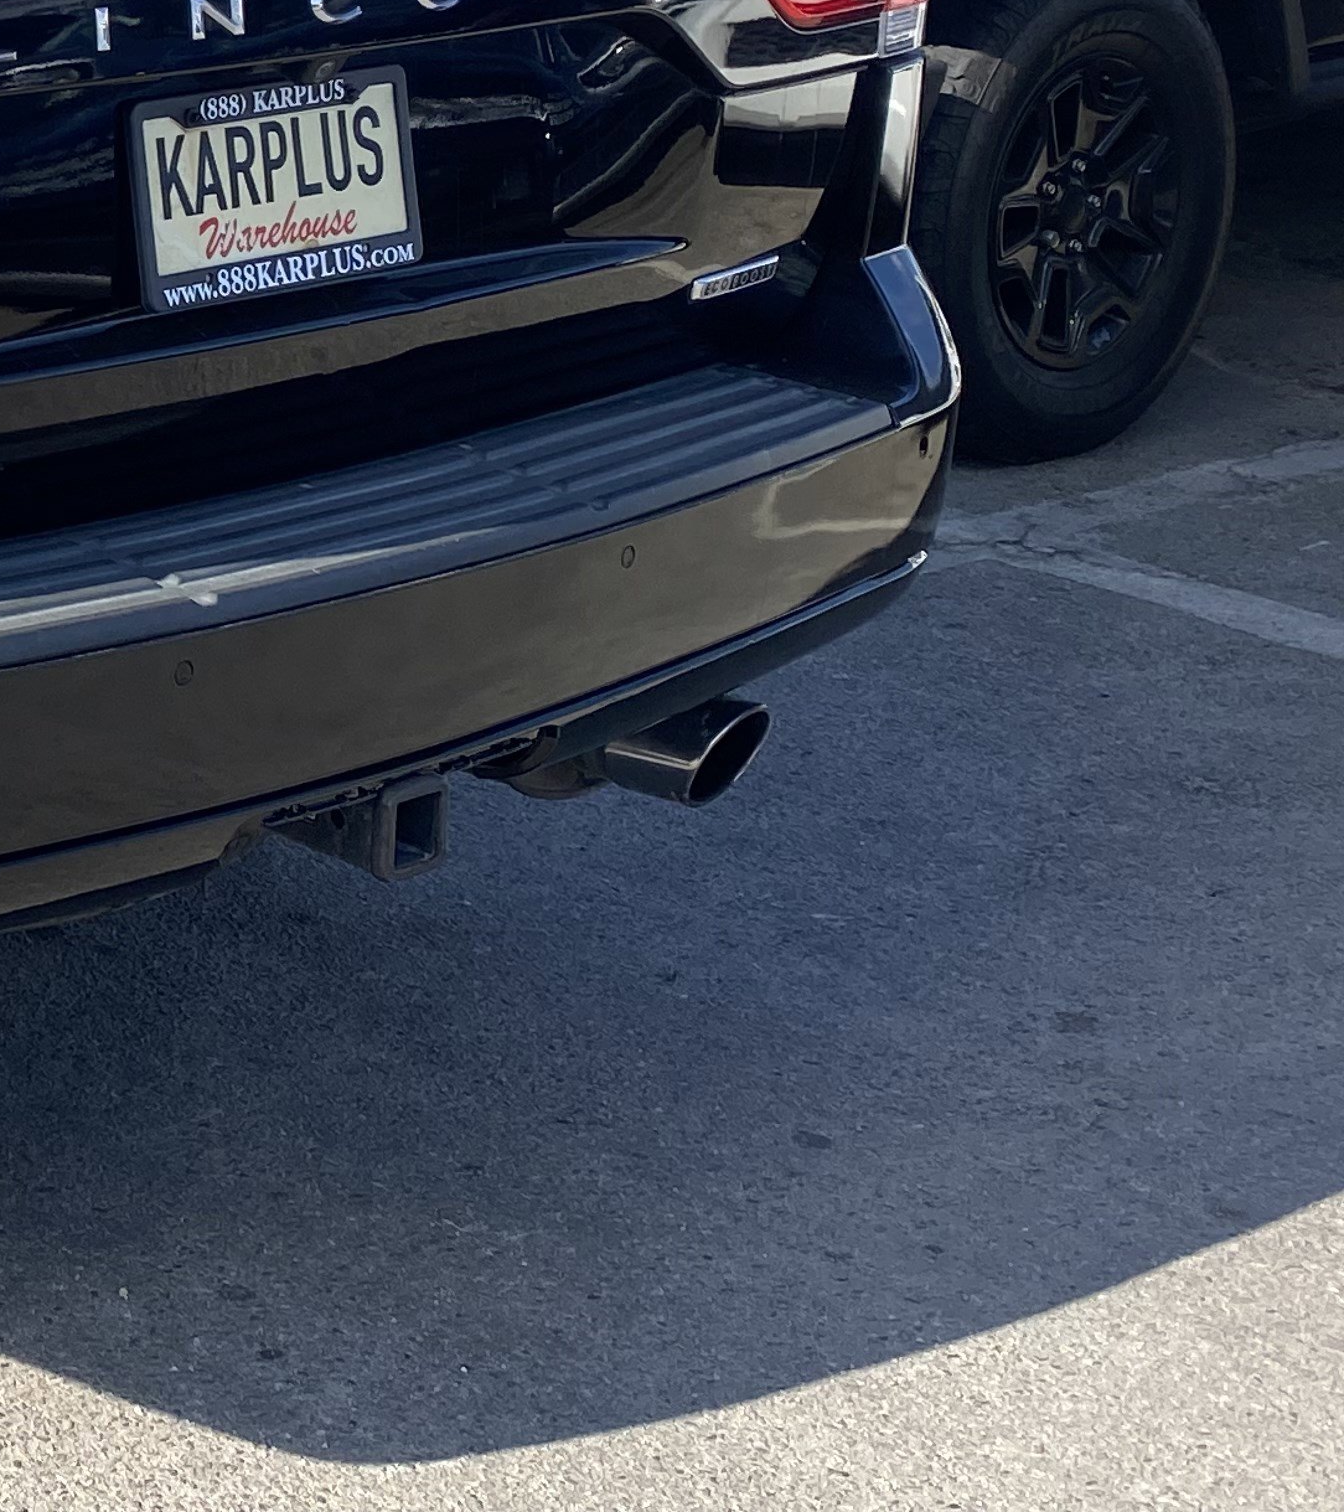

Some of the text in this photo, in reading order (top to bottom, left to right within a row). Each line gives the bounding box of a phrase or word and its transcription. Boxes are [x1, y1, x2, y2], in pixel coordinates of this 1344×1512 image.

[199, 78, 346, 122] (888) KARPLUS
[155, 105, 384, 219] KARPLUS
[199, 201, 358, 260] Warehouse
